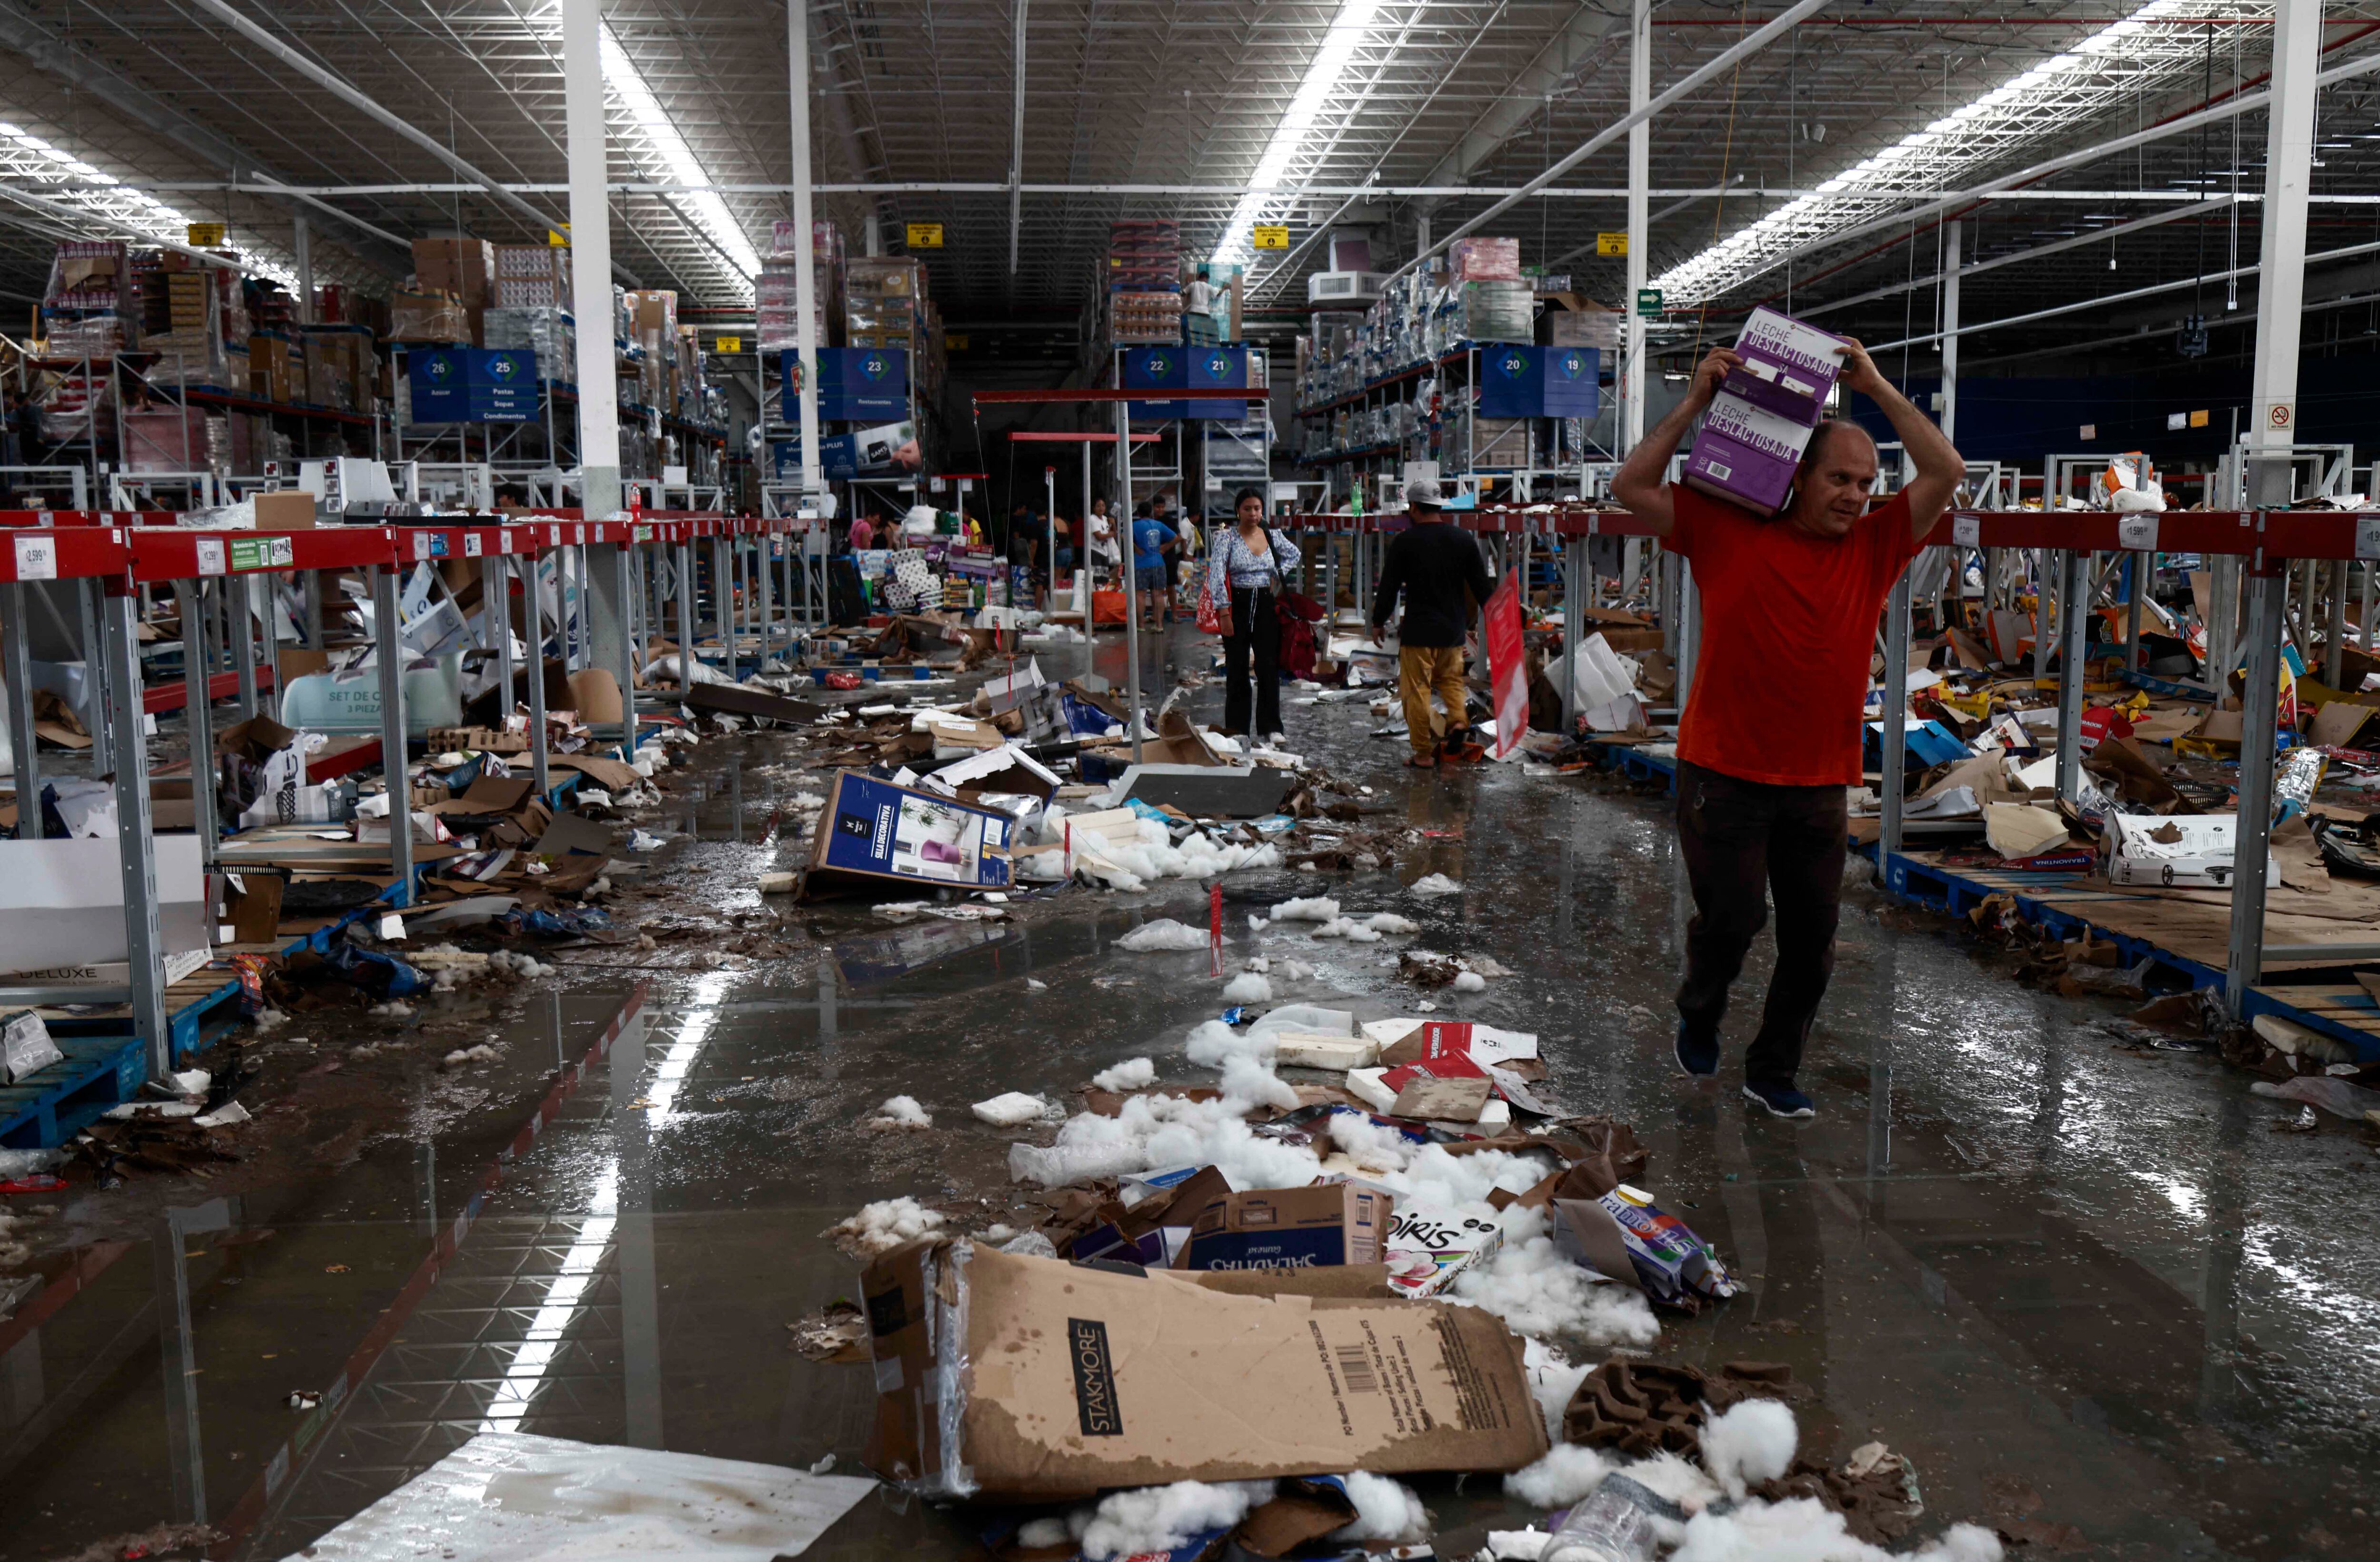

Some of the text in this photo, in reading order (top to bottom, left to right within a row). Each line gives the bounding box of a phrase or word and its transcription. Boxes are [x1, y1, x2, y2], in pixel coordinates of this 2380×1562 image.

[1754, 320, 1791, 344] LECHE
[1747, 332, 1834, 377] DESLACTOSADA
[432, 360, 446, 374] 26
[496, 359, 511, 373] 25
[868, 361, 882, 372] 23
[1150, 361, 1163, 371] 22
[1212, 361, 1224, 370] 21
[1506, 360, 1521, 370] 20
[1567, 360, 1579, 370] 19
[1715, 401, 1752, 425] LECHE
[1708, 415, 1794, 460] DESLACTOSADA
[329, 692, 350, 702] SET
[353, 692, 369, 702] DE
[347, 704, 381, 713] 3 PIEZA
[874, 805, 891, 860] SILLA DECORATIVA
[2036, 857, 2086, 865] TRAMONTINA
[167, 958, 175, 969] CUT
[20, 968, 98, 979] DELUXE
[1654, 1228, 1698, 1254] 15
[1248, 1245, 1281, 1256] Gamesa
[1375, 1355, 1384, 1368] Total
[1078, 1327, 1110, 1432] STAKMORE
[1337, 1401, 1350, 1424] Number
[1343, 1427, 1354, 1435] PO
[1396, 1419, 1407, 1433] Total
